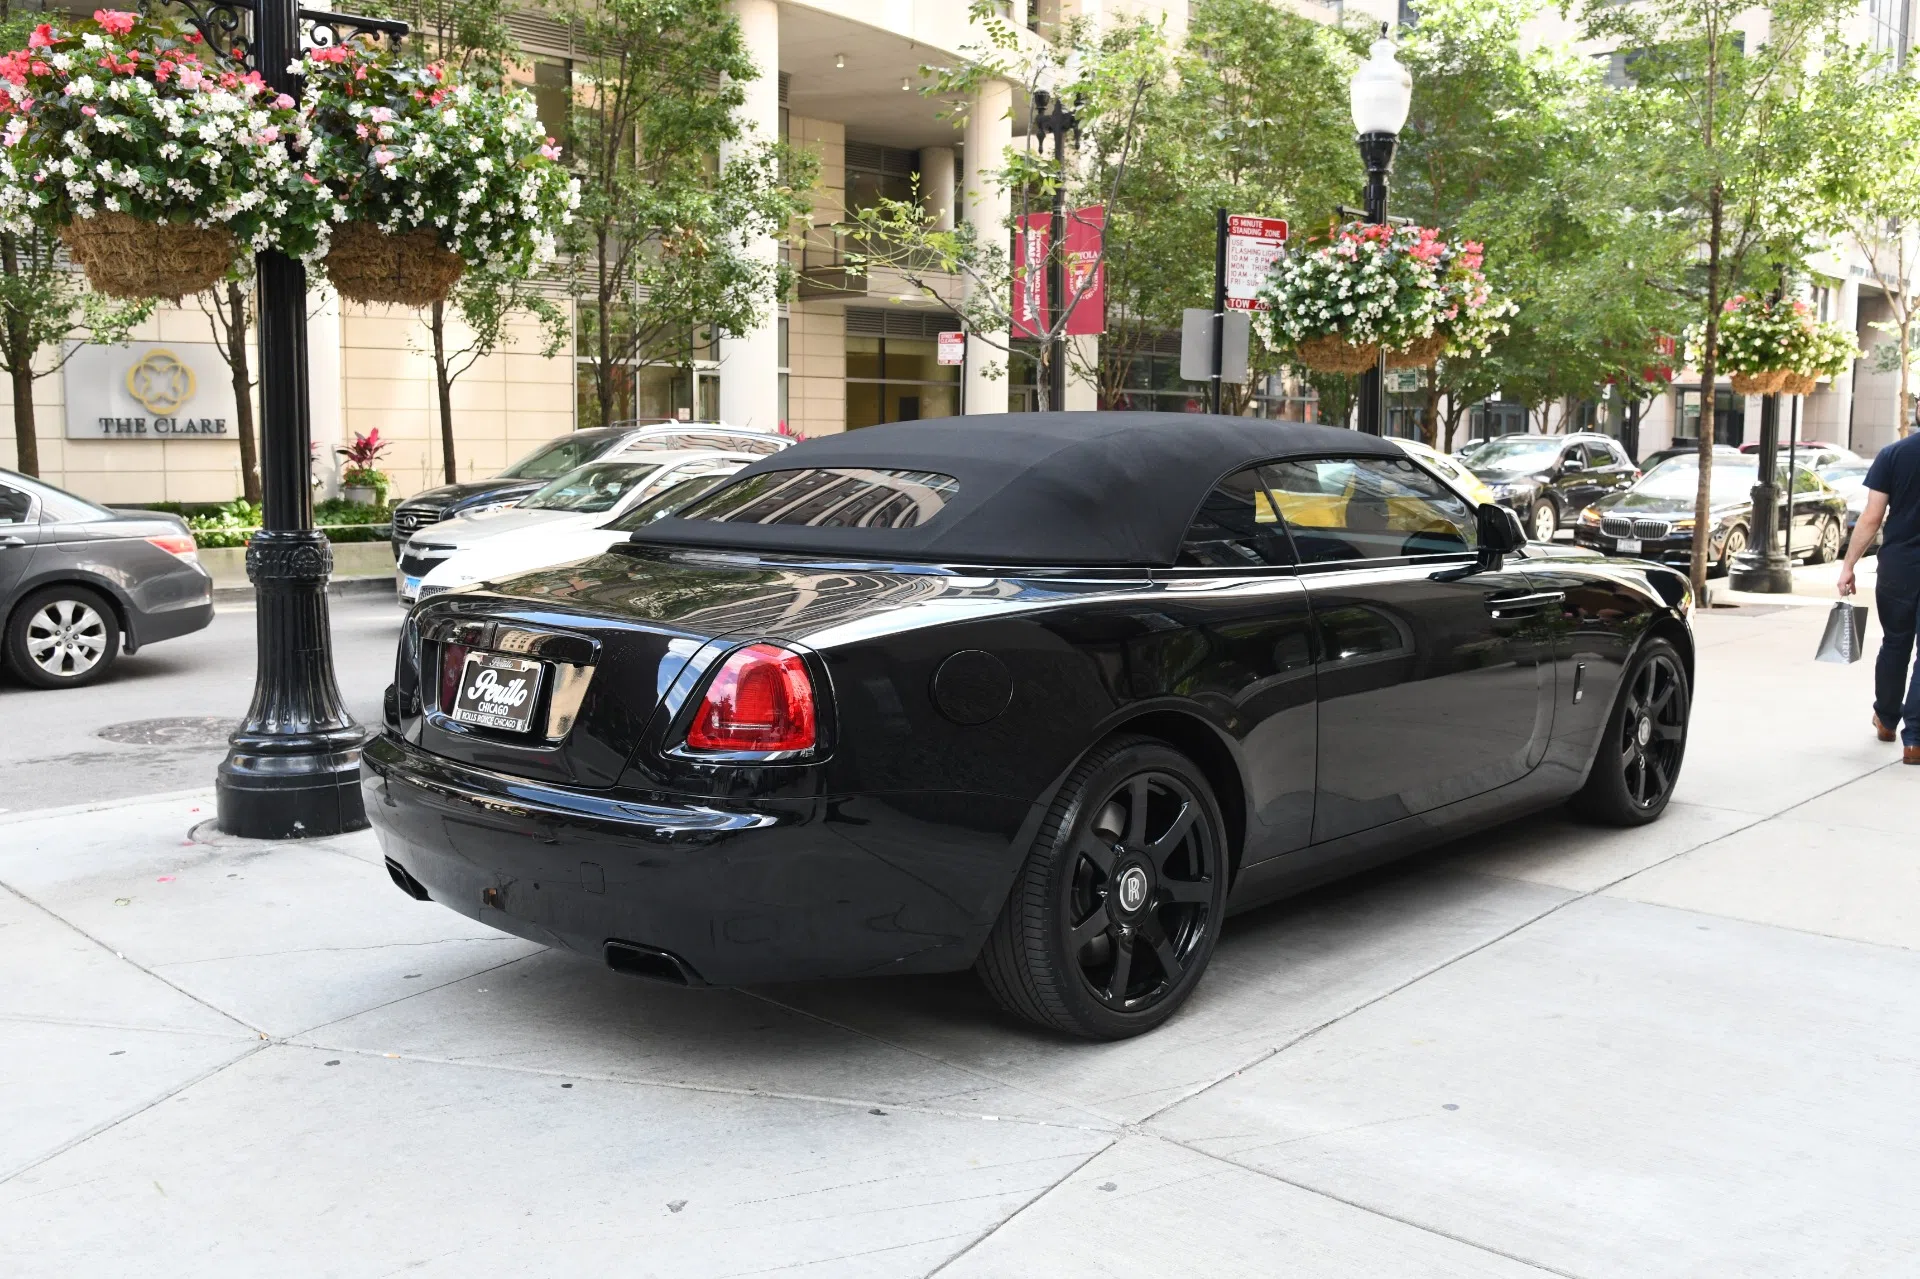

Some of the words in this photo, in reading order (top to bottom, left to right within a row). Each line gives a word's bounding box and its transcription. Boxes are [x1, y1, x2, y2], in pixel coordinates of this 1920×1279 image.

[1232, 218, 1239, 226] 15
[1240, 219, 1263, 229] MINUTE
[1232, 227, 1262, 237] STANDING
[1264, 229, 1281, 238] ZONE
[1231, 246, 1261, 256] FLASHING
[1262, 249, 1283, 258] LIGHTS
[1252, 264, 1273, 272] THURS
[1230, 299, 1250, 309] TOW
[99, 418, 147, 434] THE
[154, 417, 227, 434] CLARE
[467, 669, 528, 707] Perillo
[478, 702, 509, 716] CHICAGO
[462, 712, 477, 722] ROLLS
[477, 715, 494, 725] ROYCE
[494, 718, 516, 728] CHICAGO
